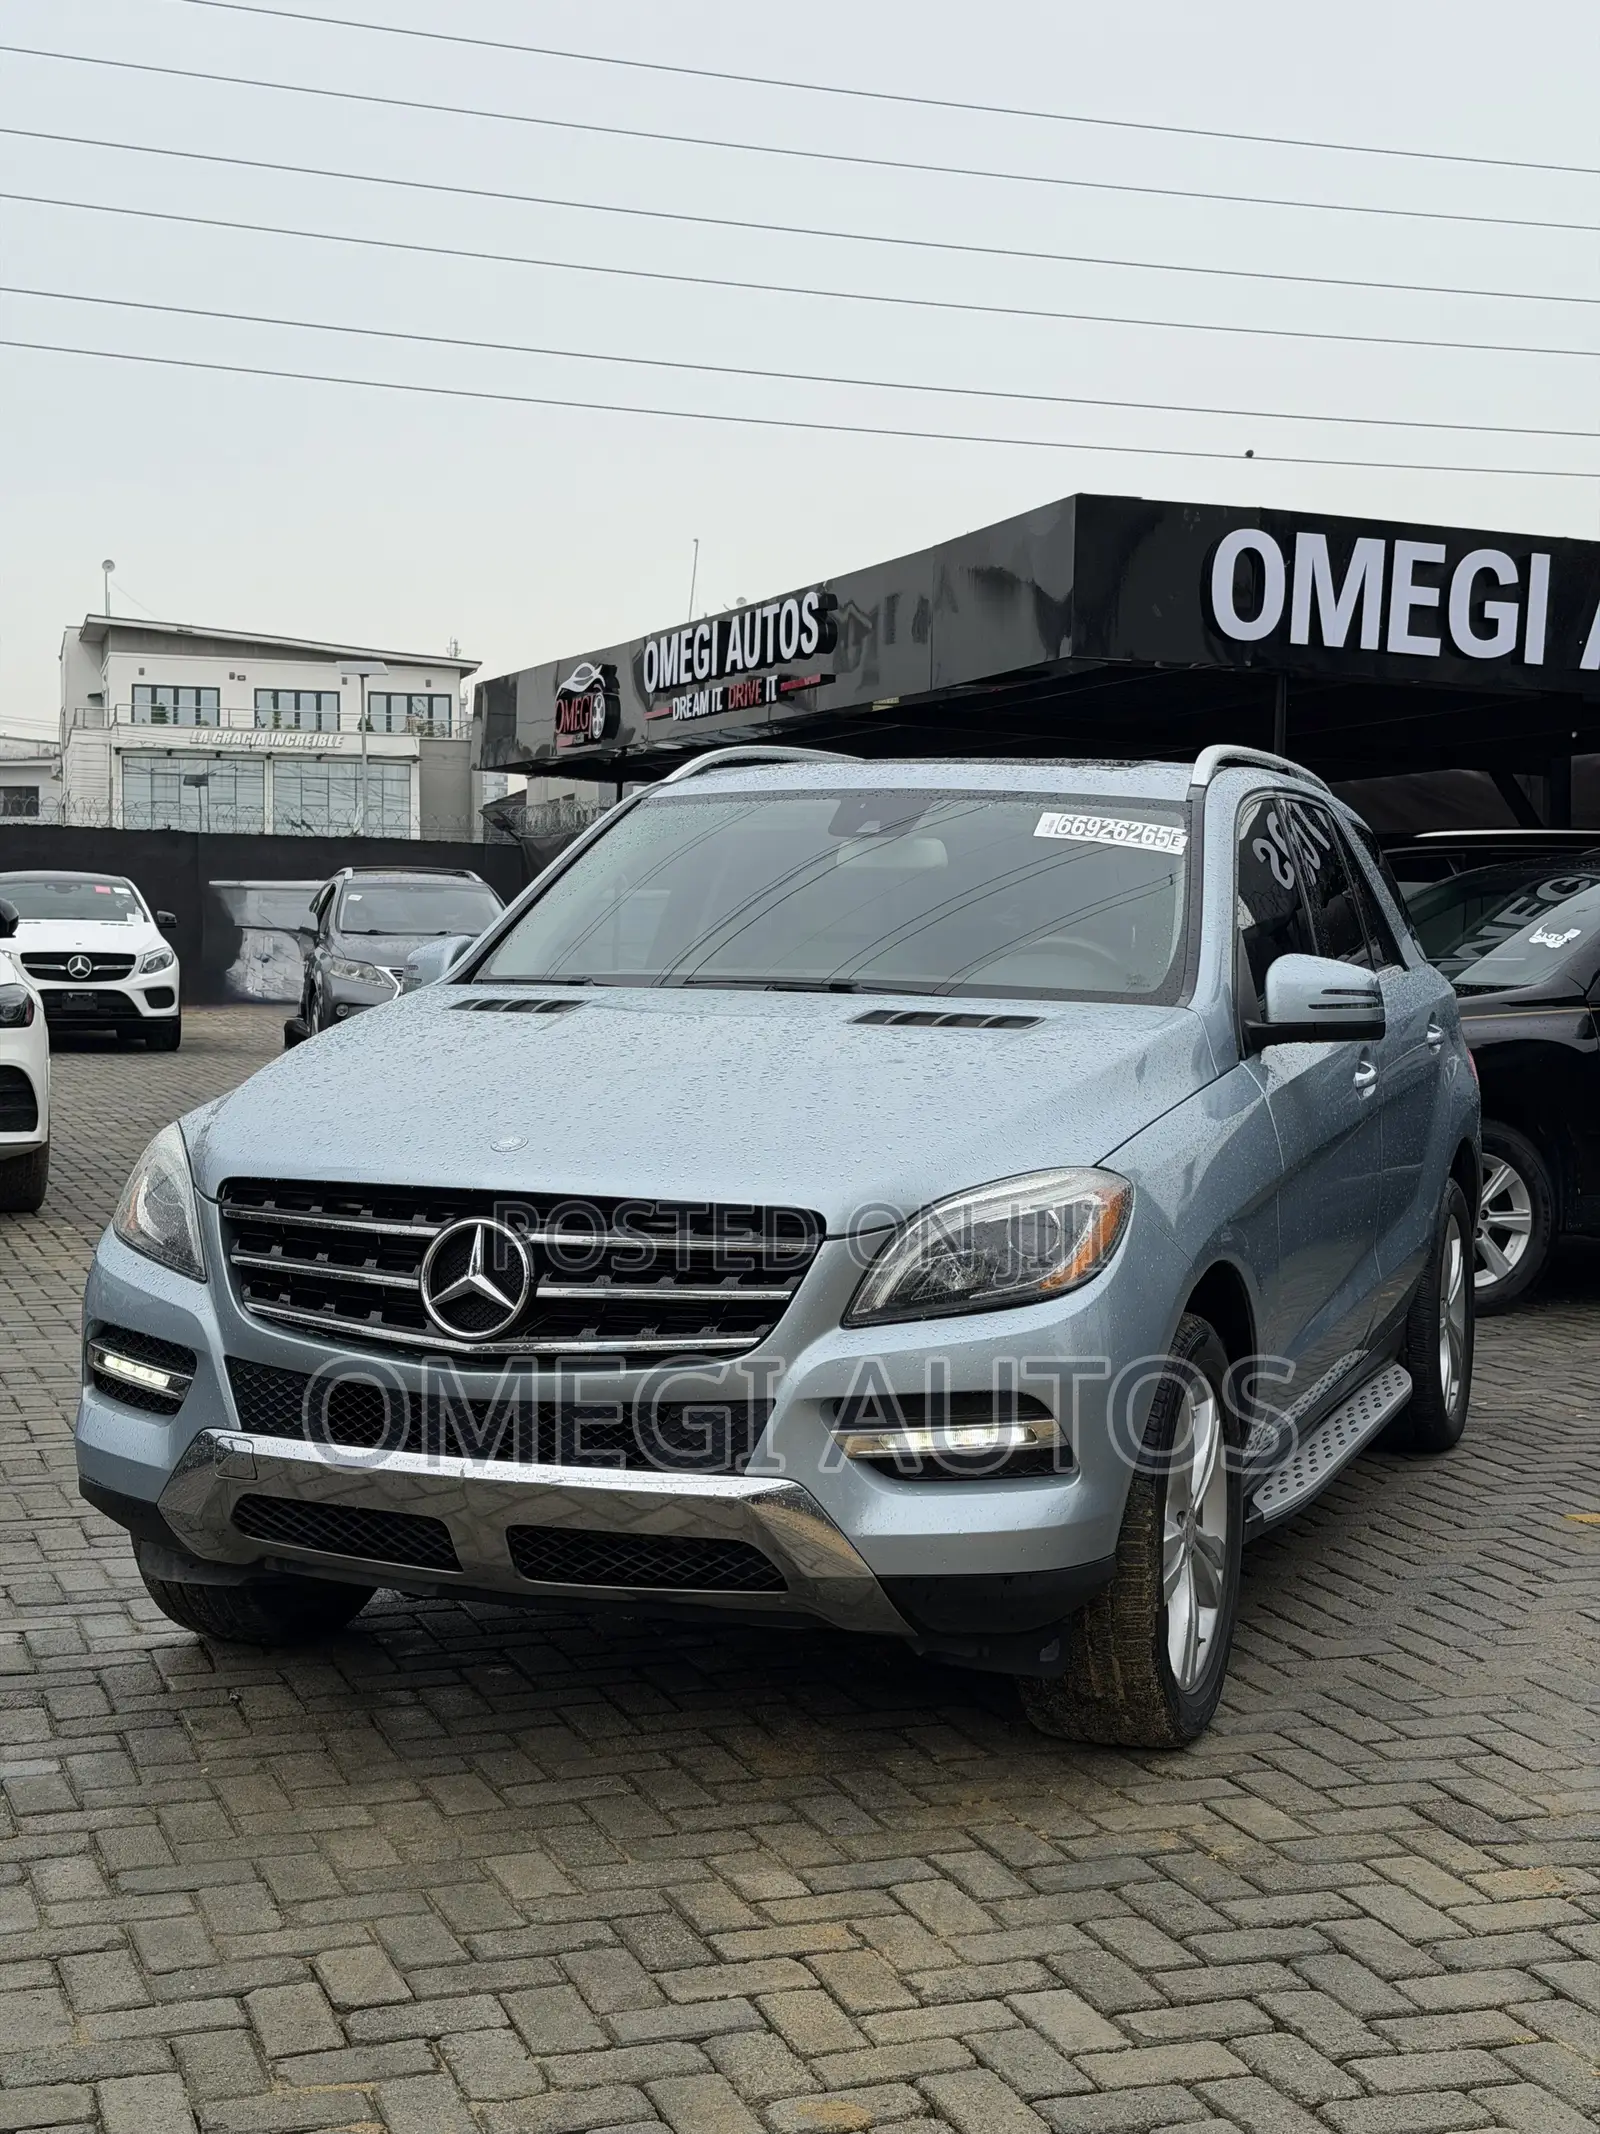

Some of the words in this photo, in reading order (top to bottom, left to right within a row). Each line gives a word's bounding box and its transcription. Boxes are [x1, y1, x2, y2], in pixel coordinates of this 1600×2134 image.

[1211, 528, 1551, 665] OMEGI
[643, 620, 718, 693] OMEGI
[725, 591, 820, 673] AUTOS
[555, 694, 594, 739] OMEGI
[672, 688, 710, 721] DREAM
[711, 687, 724, 713] IT
[728, 679, 763, 710] DRIVE
[766, 675, 778, 703] IT
[190, 731, 209, 744] LA
[211, 731, 266, 746] GRACIA
[1055, 814, 1170, 849] 66926265
